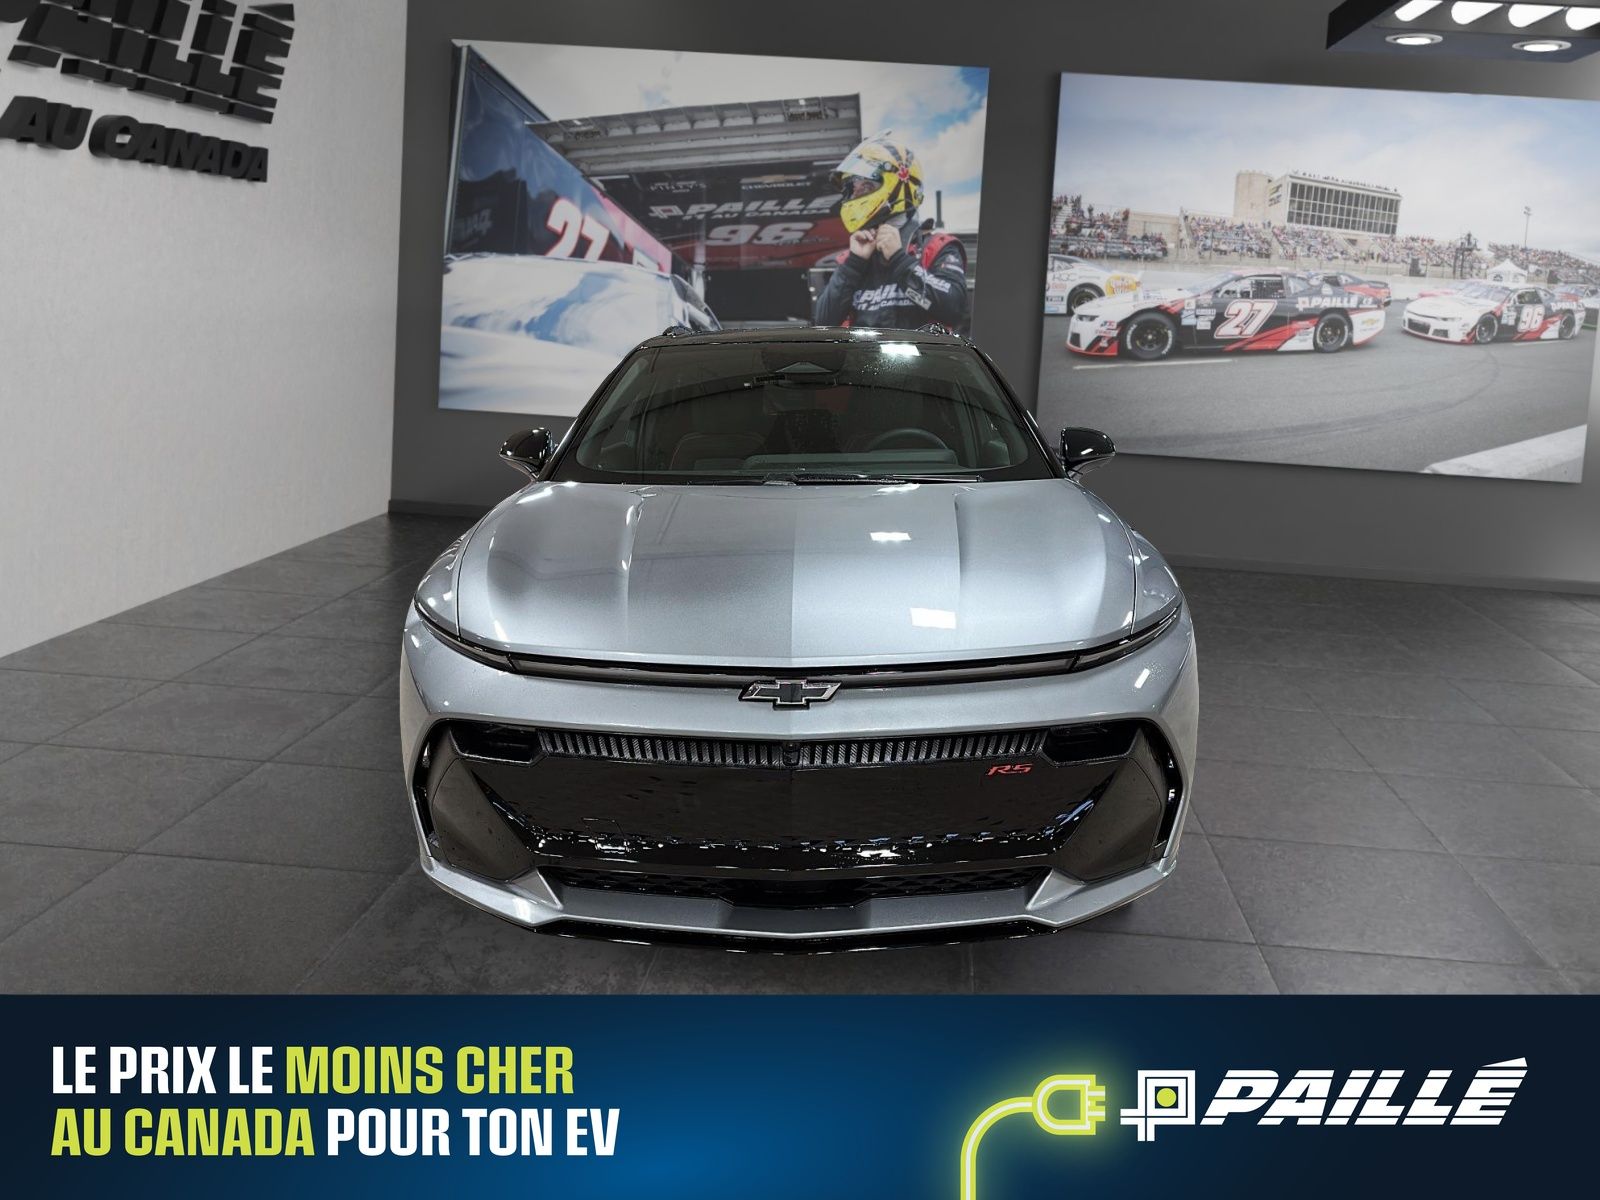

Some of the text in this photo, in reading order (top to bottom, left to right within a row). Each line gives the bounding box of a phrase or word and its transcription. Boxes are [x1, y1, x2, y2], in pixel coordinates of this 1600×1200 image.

[0, 95, 268, 182] AU CANADA
[706, 222, 814, 246] 96
[1213, 299, 1278, 340] 27
[1517, 304, 1546, 333] 96
[987, 763, 1033, 776] RS
